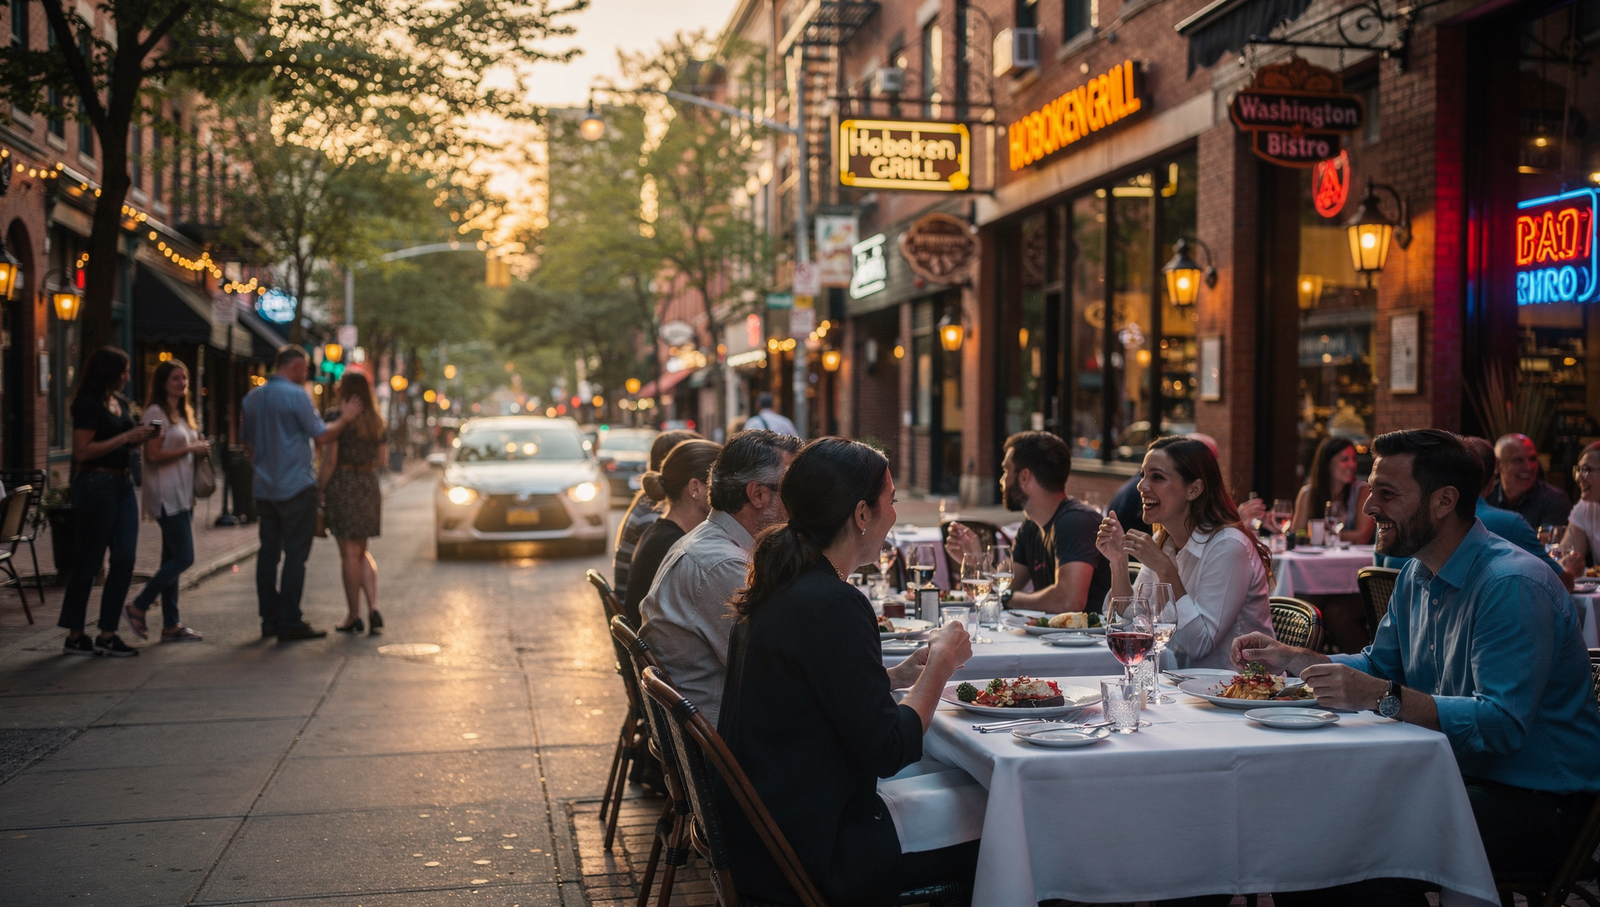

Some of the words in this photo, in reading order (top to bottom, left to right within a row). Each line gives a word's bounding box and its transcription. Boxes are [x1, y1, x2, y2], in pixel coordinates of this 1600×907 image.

[1238, 95, 1358, 128] Washington
[849, 128, 956, 160] Hoboken
[1267, 132, 1330, 158] Bistro
[870, 156, 941, 180] GRILL
